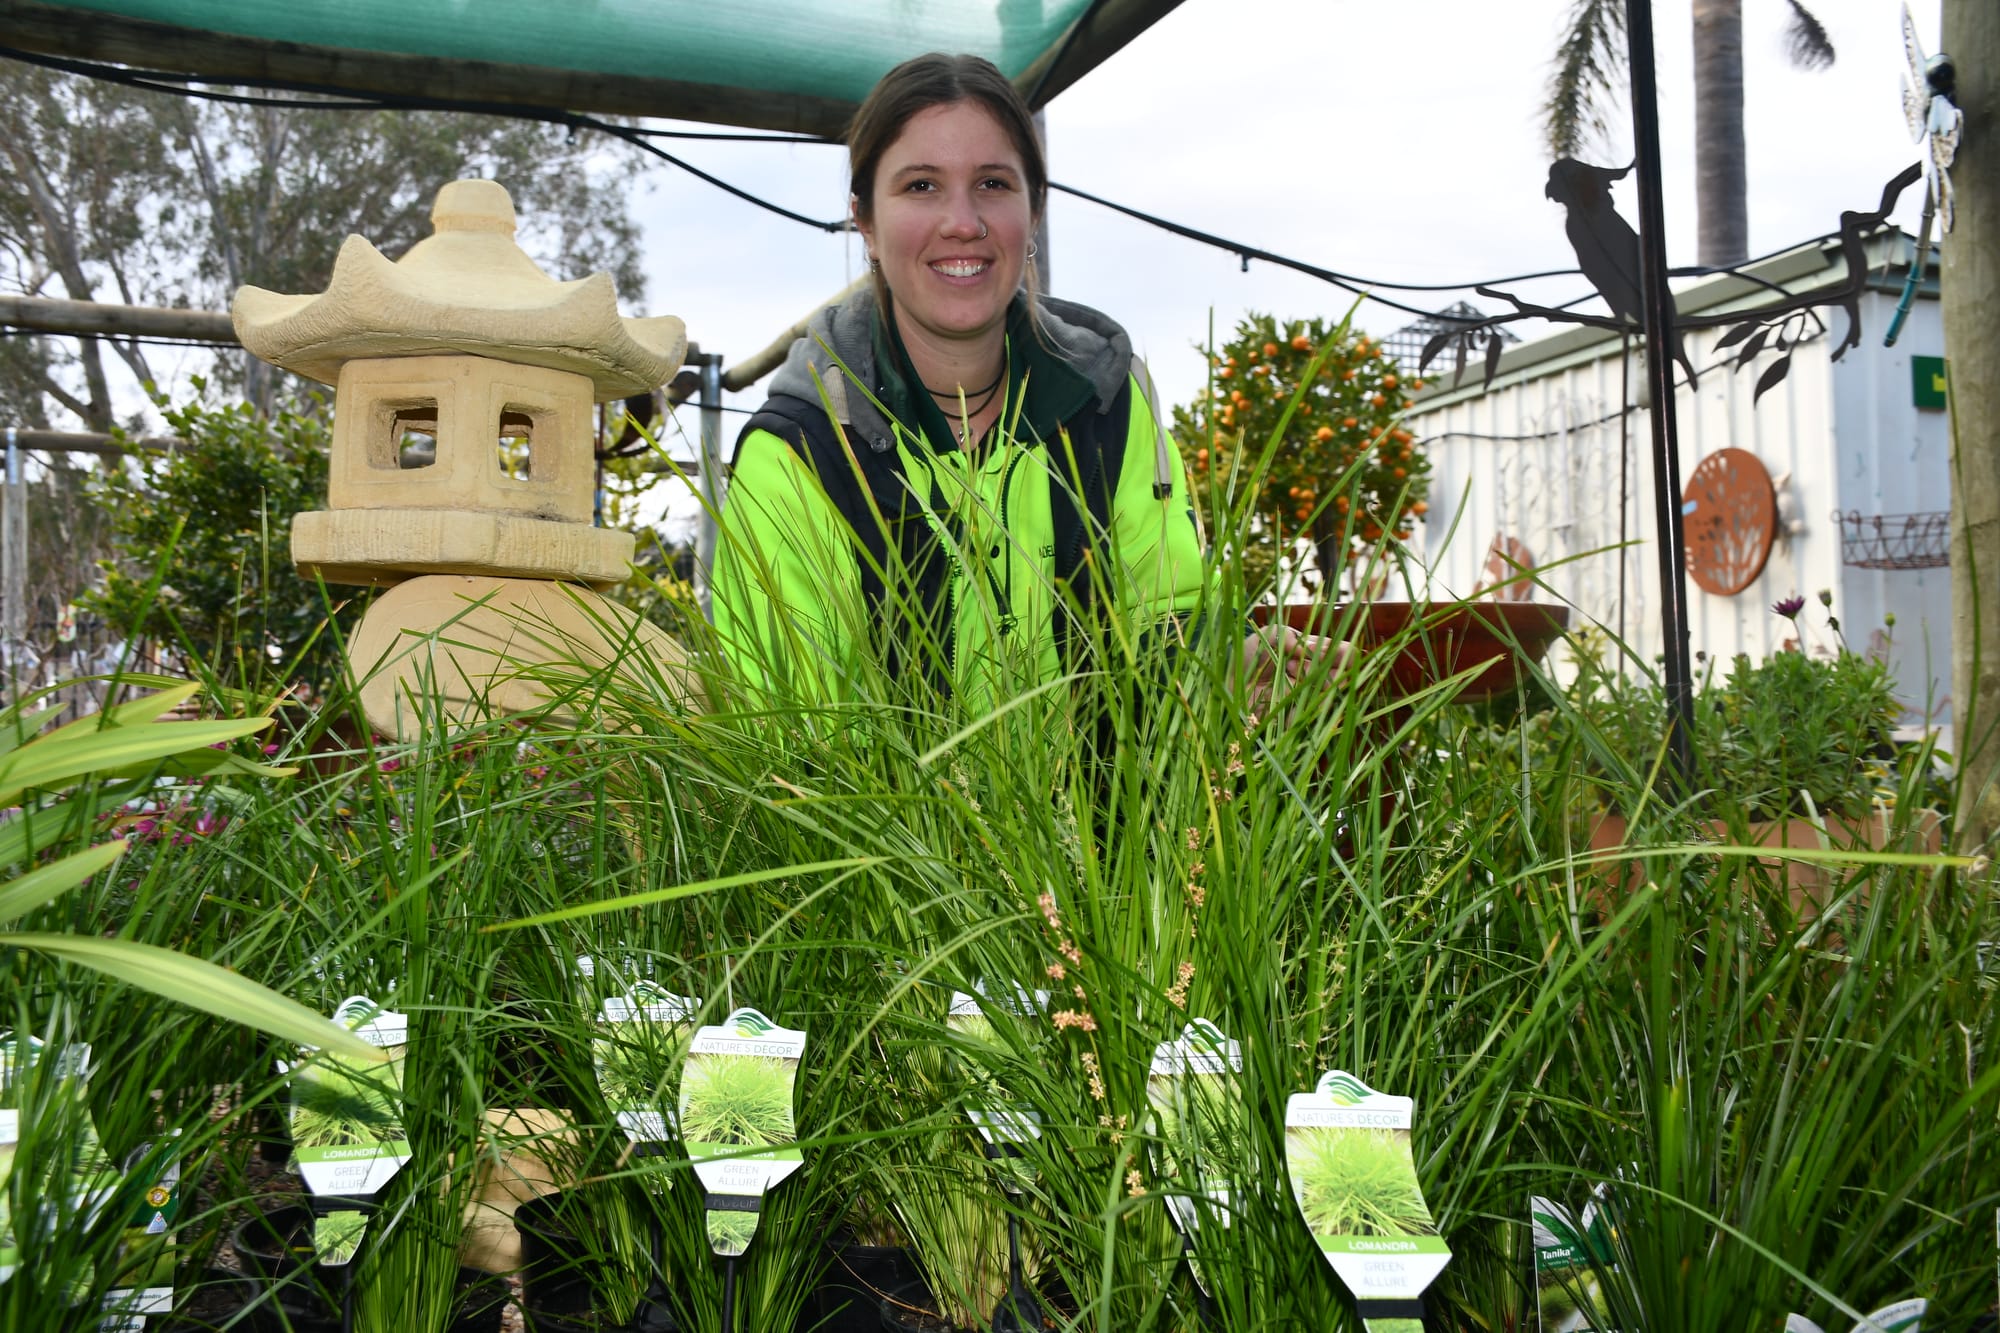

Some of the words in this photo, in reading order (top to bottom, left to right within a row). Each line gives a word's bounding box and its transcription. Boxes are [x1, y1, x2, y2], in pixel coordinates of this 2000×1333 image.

[322, 1147, 384, 1160] LOMANDRA
[334, 1165, 370, 1177] GREEN
[723, 1164, 760, 1175] GREEN
[718, 1176, 759, 1188] ALLURE
[1348, 1240, 1418, 1252] LOMANDRA
[1364, 1260, 1405, 1273] GREEN
[1363, 1275, 1408, 1288] ALLURE
